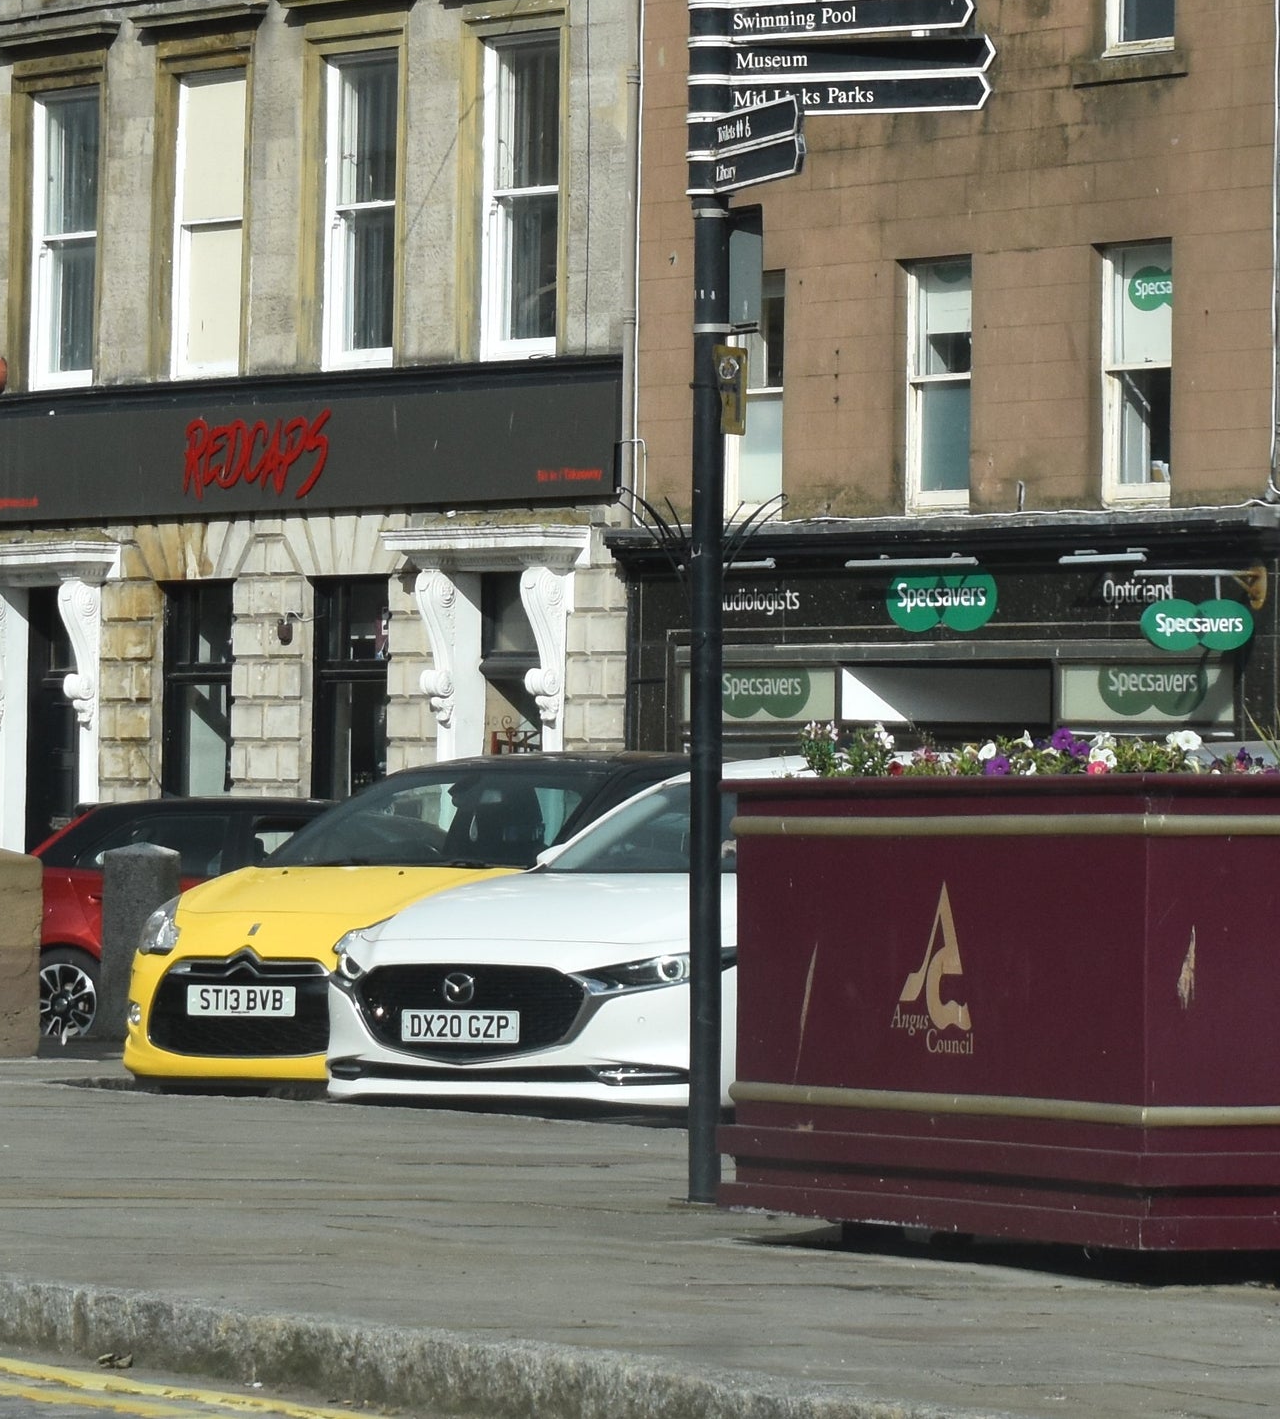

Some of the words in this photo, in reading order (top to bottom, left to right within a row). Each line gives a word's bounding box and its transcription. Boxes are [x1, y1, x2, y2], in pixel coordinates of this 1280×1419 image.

[733, 10, 815, 29] Swimming
[821, 6, 856, 24] Pool
[736, 52, 808, 69] Museum
[734, 89, 766, 107] Mid
[827, 86, 874, 104] Parks
[717, 124, 736, 143] Toilets
[716, 164, 736, 182] Library
[183, 408, 332, 501] REDCAPS
[896, 583, 987, 613] Specsavers
[1155, 613, 1244, 637] Specsavers
[723, 673, 802, 700] Specsavers
[1108, 669, 1198, 697] Specsavers
[200, 988, 241, 1011] ST13
[246, 989, 284, 1011] BVB
[410, 1014, 462, 1038] DX20
[468, 1015, 510, 1039] GZP
[890, 1003, 930, 1036] Angus
[926, 1028, 975, 1054] Council
